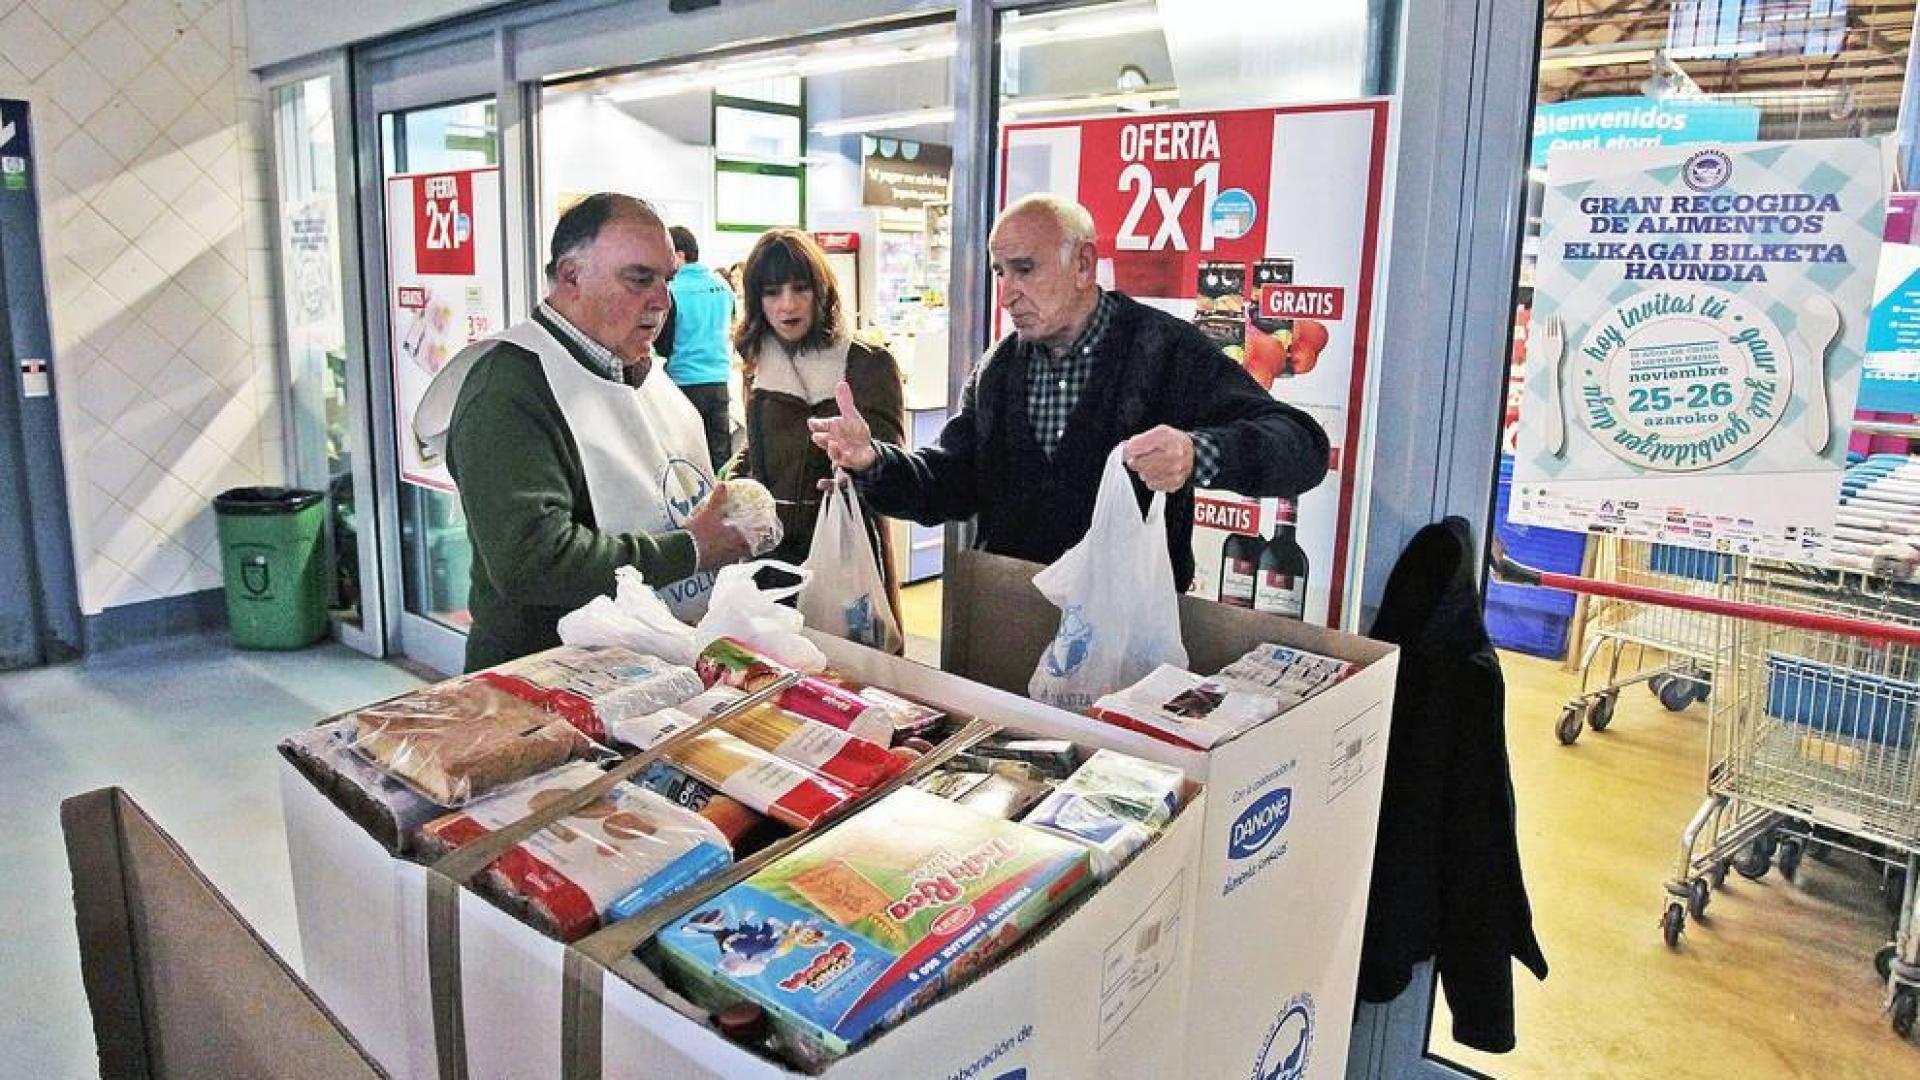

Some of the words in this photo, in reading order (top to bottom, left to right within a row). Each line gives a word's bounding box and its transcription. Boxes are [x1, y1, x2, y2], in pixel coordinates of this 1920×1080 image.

[1120, 120, 1221, 162] OFERTA
[1115, 162, 1220, 251] 2x1
[1580, 197, 1662, 214] GRAN
[1670, 194, 1841, 213] RECOGIDA
[426, 199, 459, 249] 2x1
[1590, 217, 1629, 233] DE
[1635, 215, 1823, 233] ALIMENTOS
[1563, 243, 1701, 260] ELIKAGAI
[1709, 243, 1847, 262] BILKETA
[1625, 263, 1767, 282] HAUNDIA
[1269, 291, 1334, 315] GRATIS
[1583, 325, 1626, 362] hoy
[1617, 292, 1696, 329] invitas
[1629, 365, 1729, 382] noviembre
[1629, 382, 1733, 412] 25-26
[1644, 412, 1719, 427] azaroko
[1195, 502, 1250, 530] GRATIS
[1233, 795, 1289, 847] DANONE
